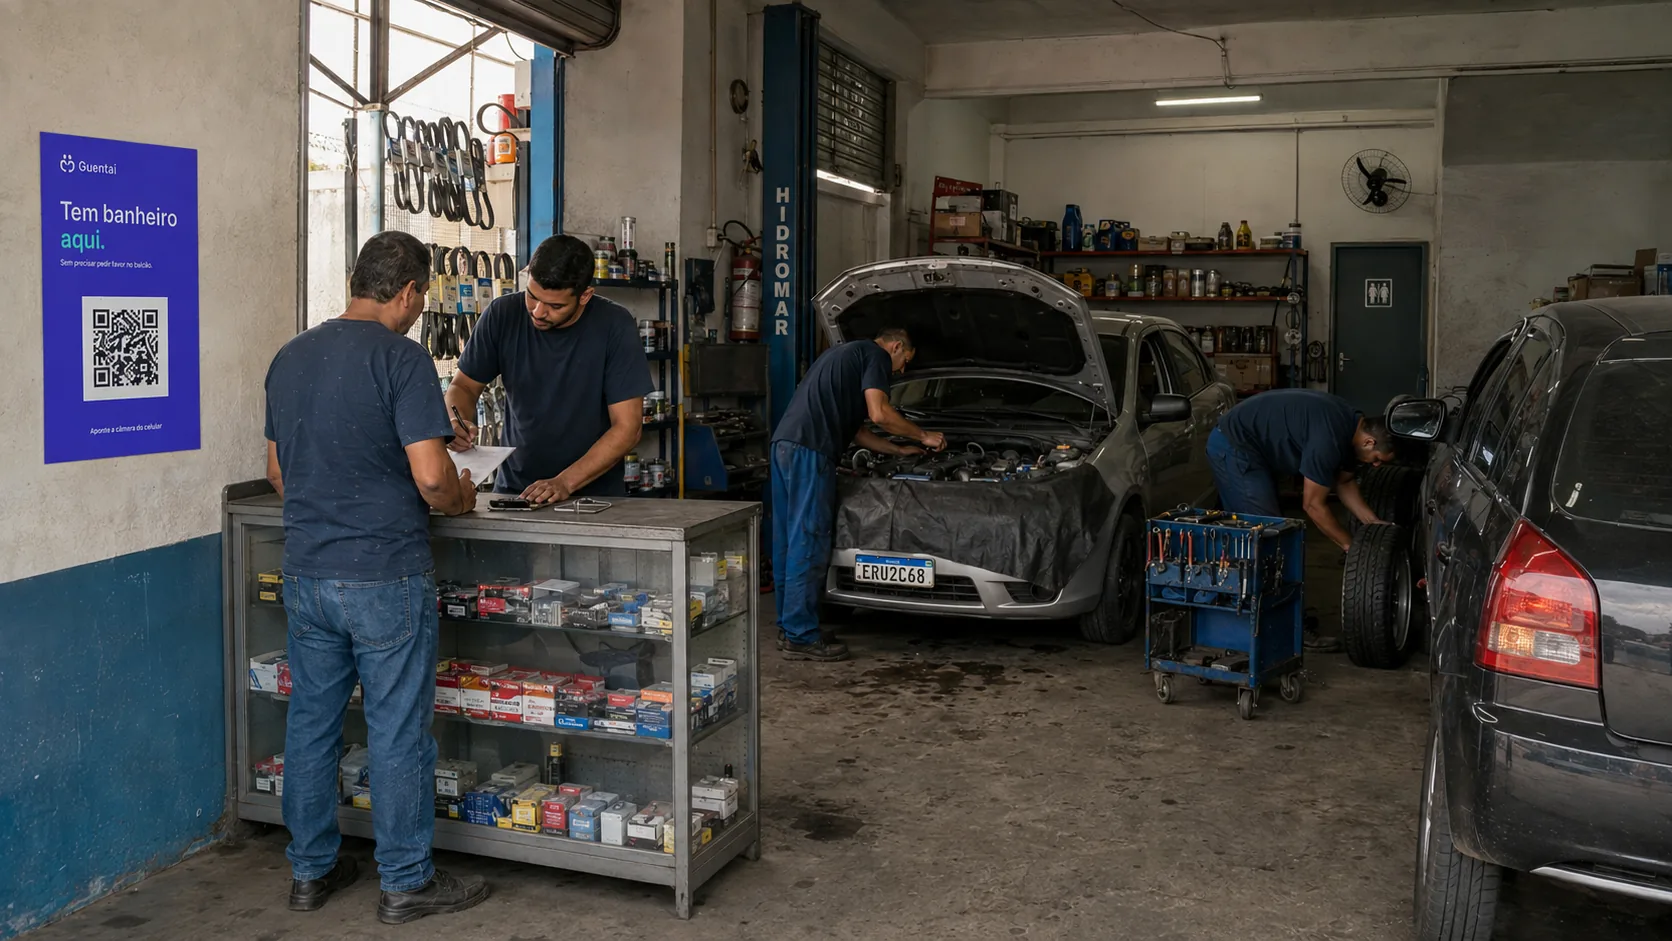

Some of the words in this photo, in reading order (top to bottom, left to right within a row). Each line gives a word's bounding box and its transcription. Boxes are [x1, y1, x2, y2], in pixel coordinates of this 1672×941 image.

[78, 160, 117, 175] Guentai
[60, 201, 98, 222] Tem
[103, 203, 178, 227] banheiro
[60, 229, 105, 254] aqui.
[60, 258, 73, 267] Sem
[774, 186, 790, 336] HIDROMAR
[862, 564, 925, 584] ERU2C68
